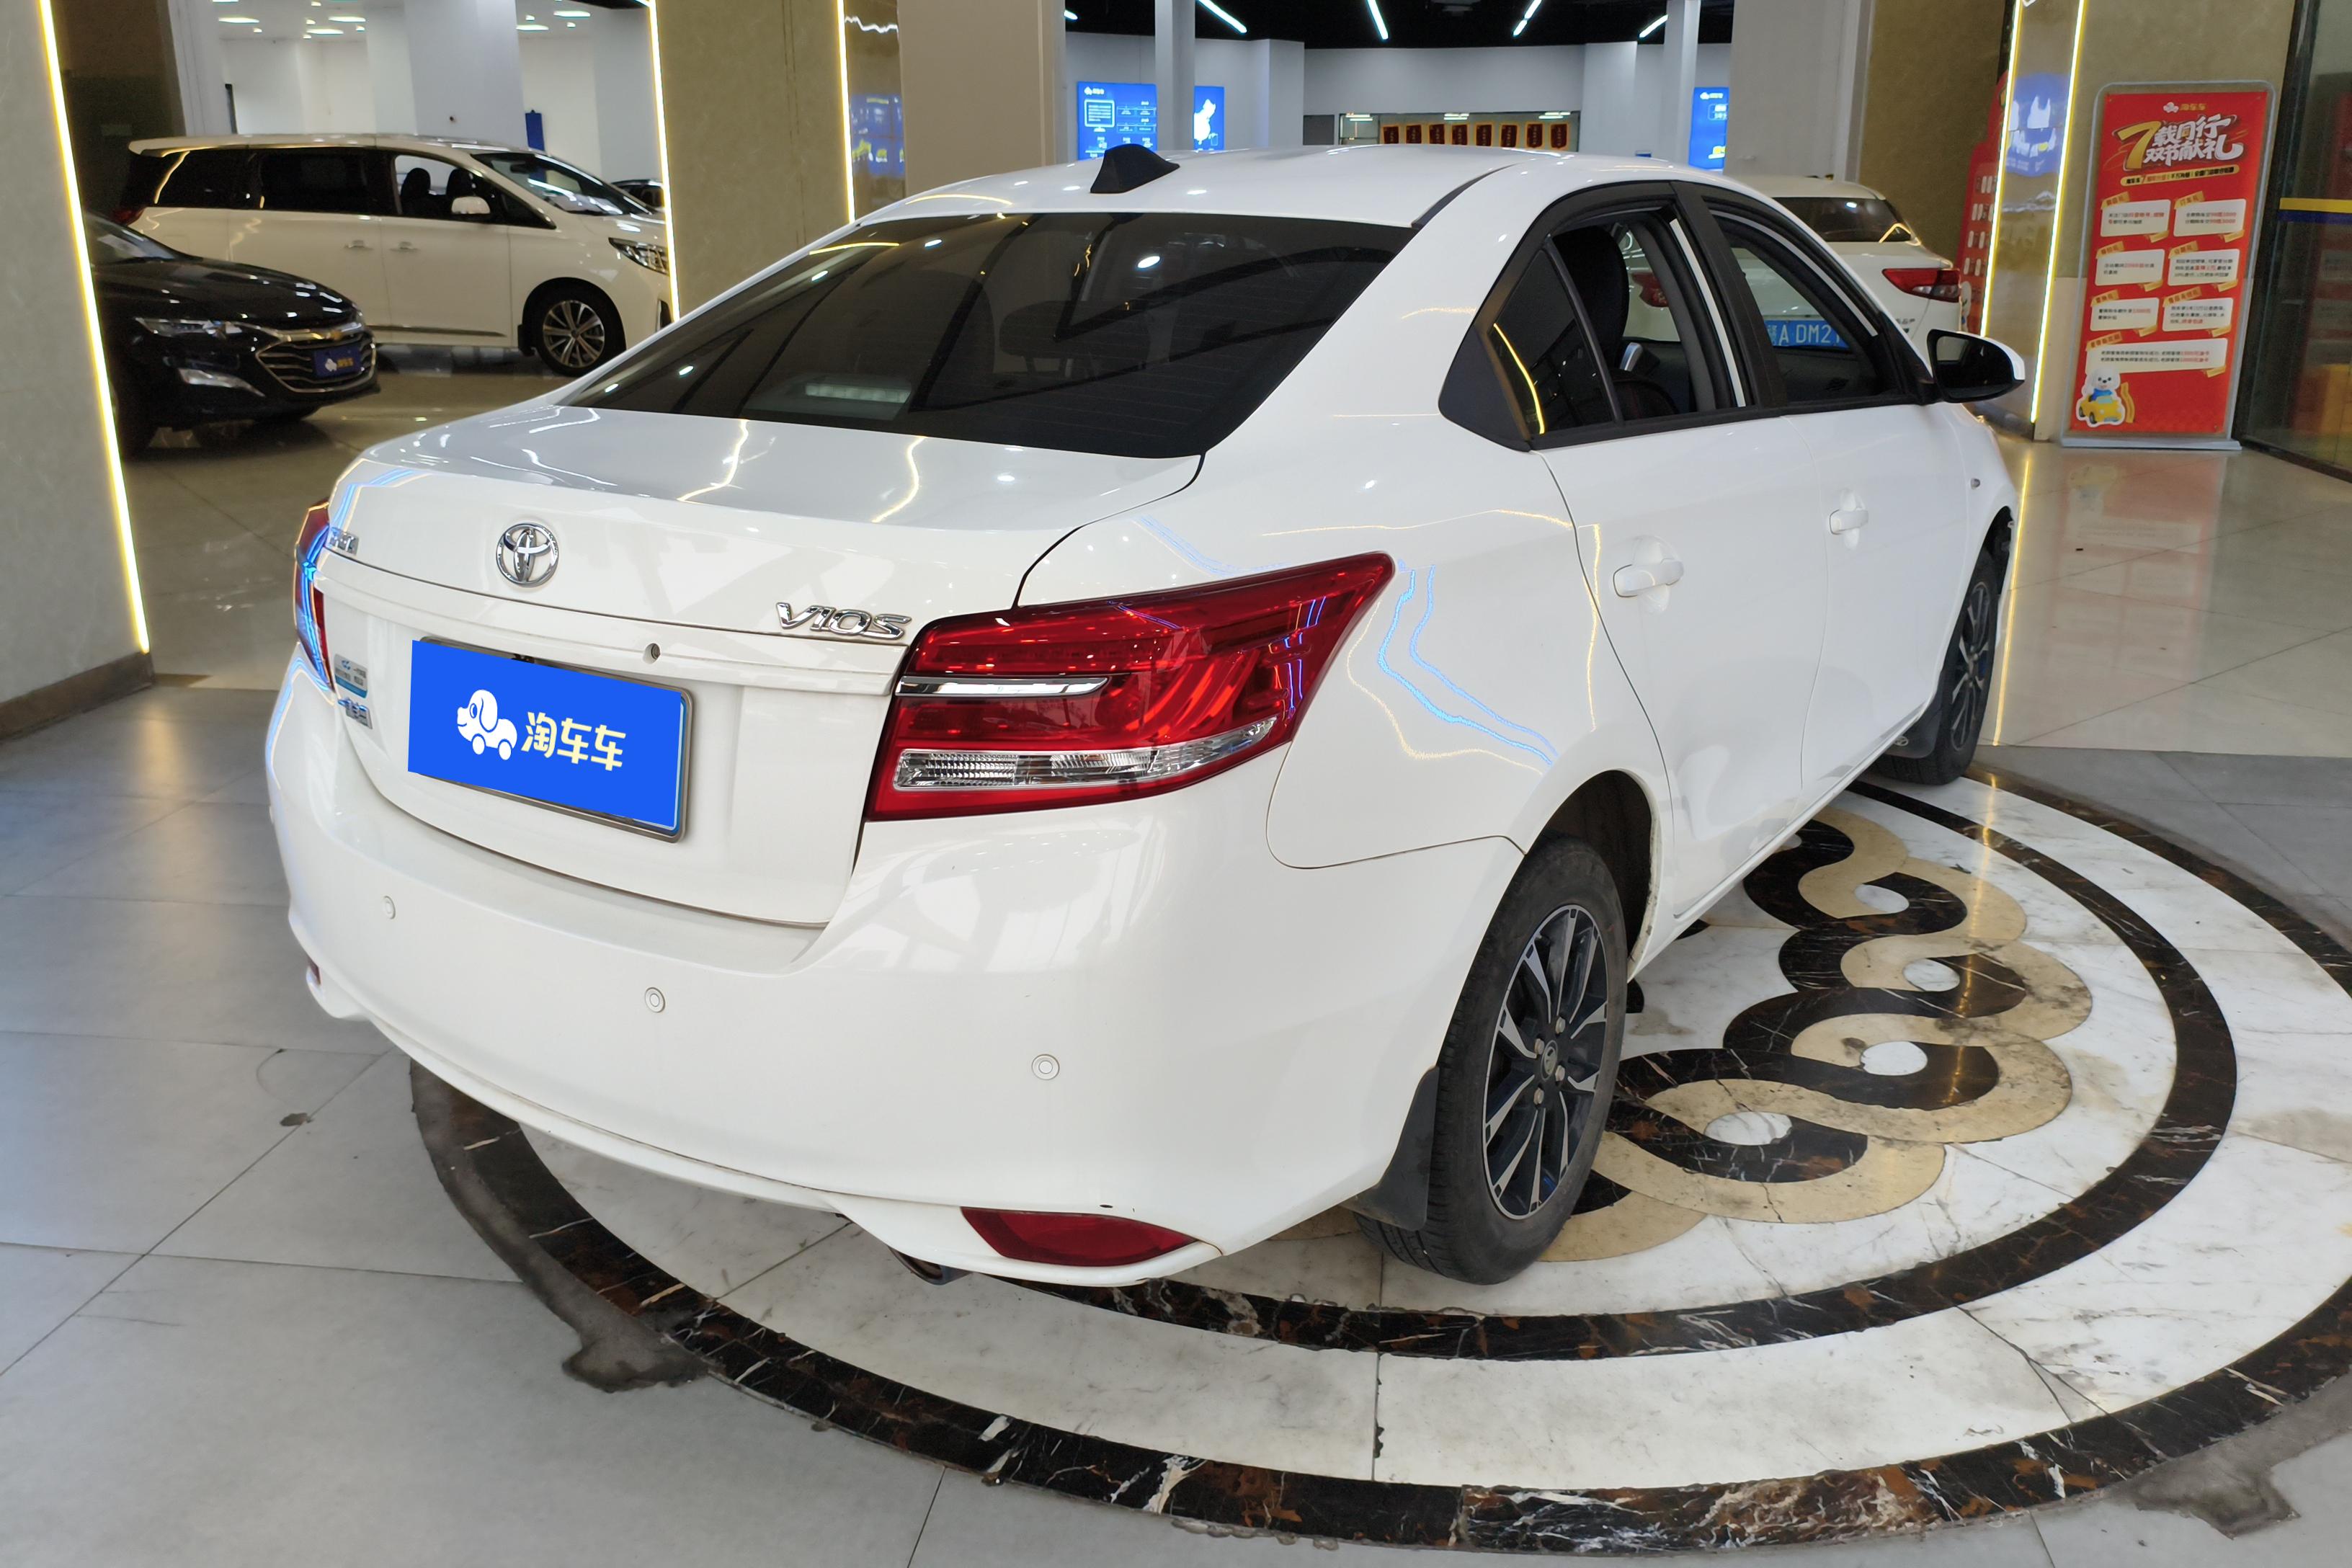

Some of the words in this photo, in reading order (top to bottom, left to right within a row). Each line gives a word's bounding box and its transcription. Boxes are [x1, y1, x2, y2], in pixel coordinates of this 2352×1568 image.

[2142, 134, 2244, 166] 双节献礼
[776, 602, 912, 641] VIOS
